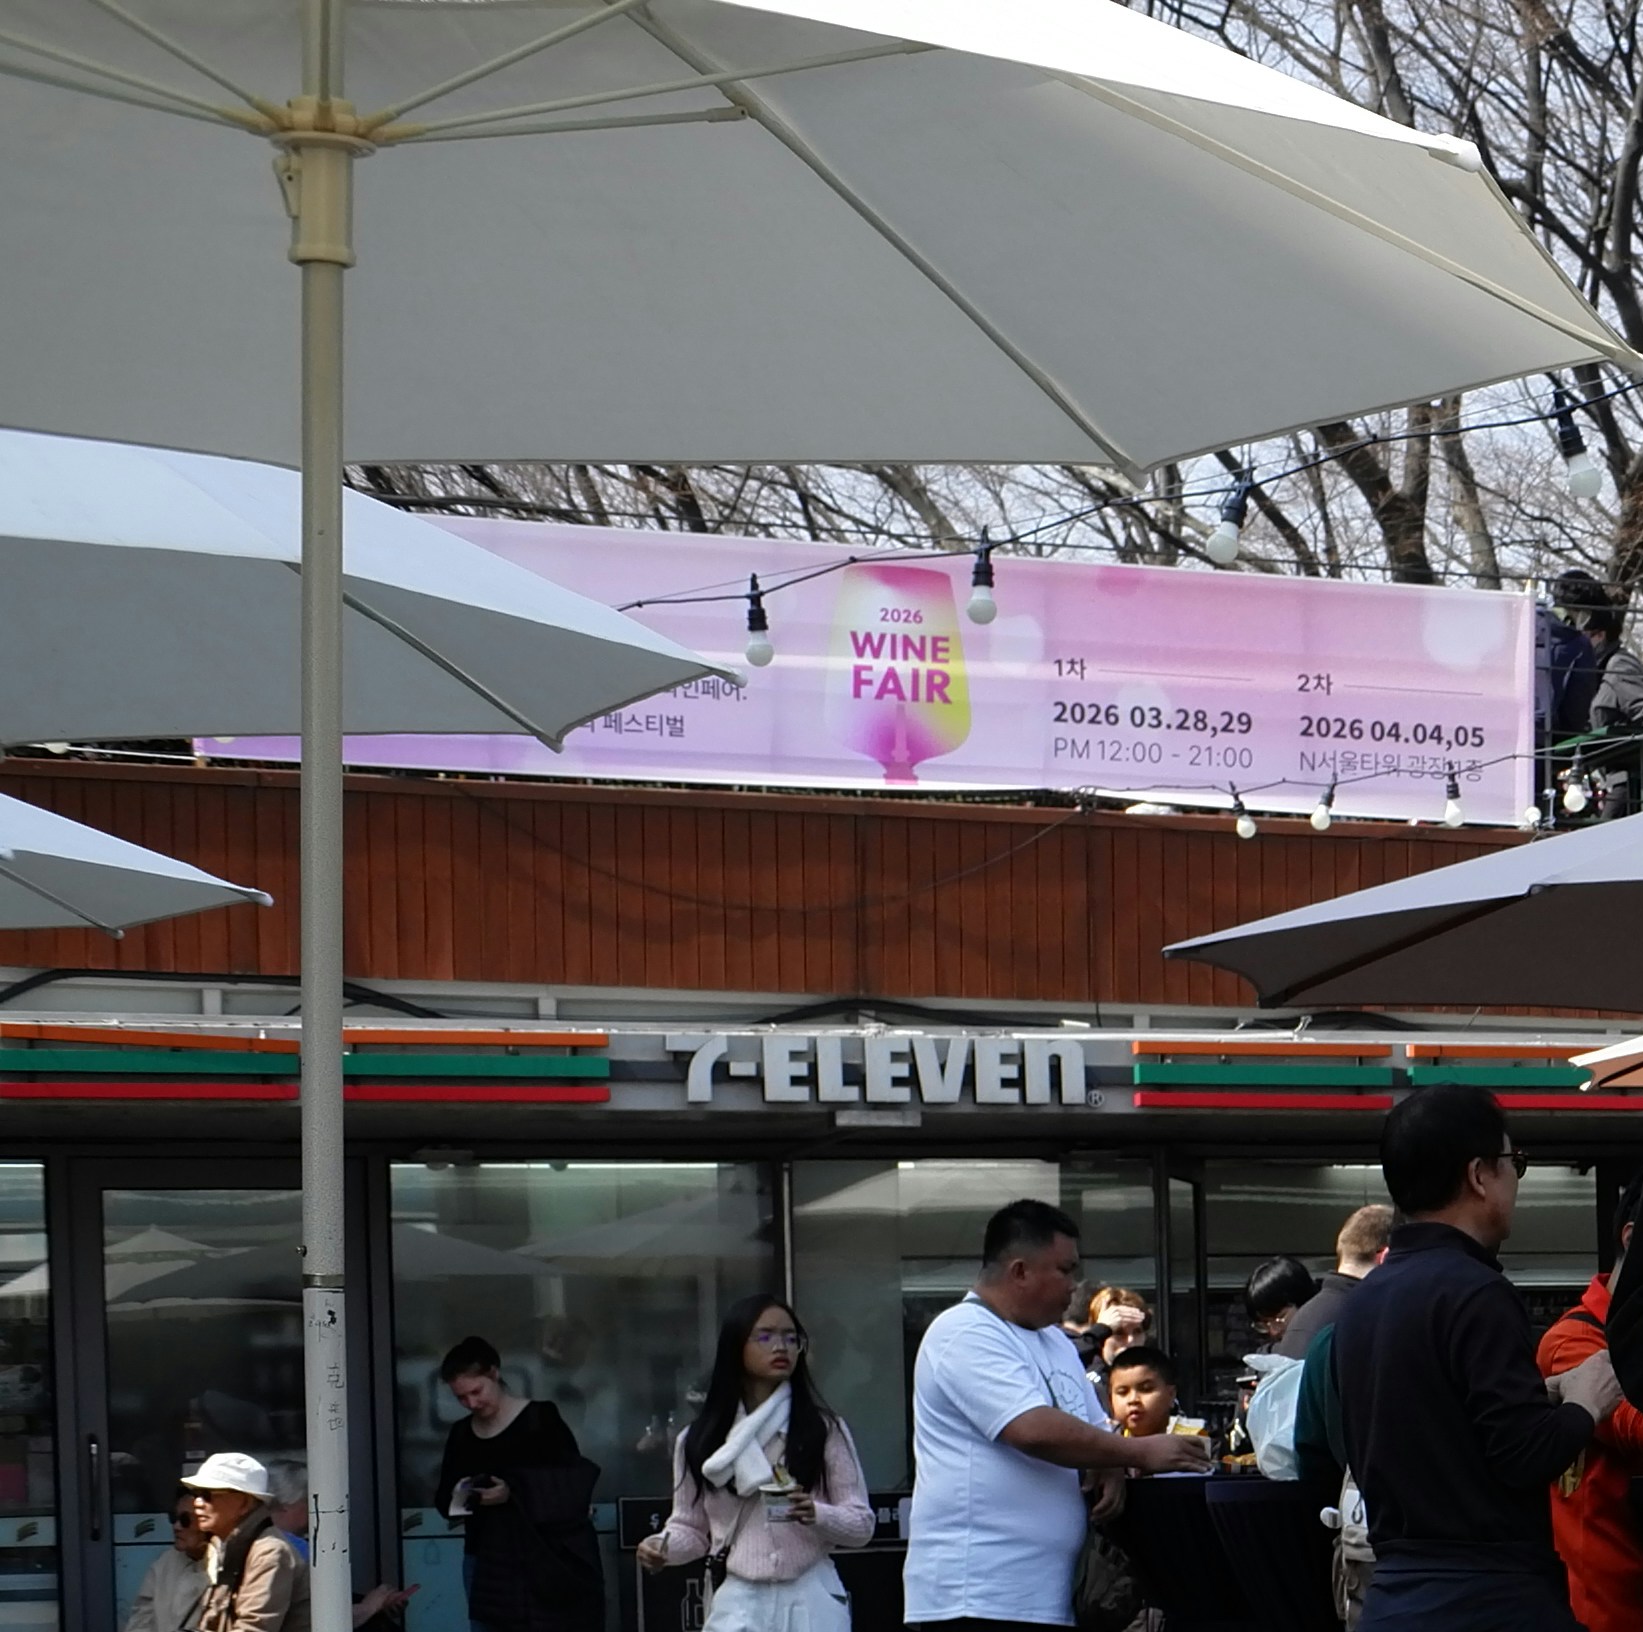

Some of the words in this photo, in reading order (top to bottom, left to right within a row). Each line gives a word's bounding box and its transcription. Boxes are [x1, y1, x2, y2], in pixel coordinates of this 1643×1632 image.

[880, 608, 923, 624] 2026
[850, 630, 950, 664] WINE
[1053, 658, 1086, 680] 1차
[853, 665, 952, 705] FAIR
[1297, 673, 1333, 696] 2차
[602, 711, 686, 739] 페스티벌
[1053, 701, 1119, 726] 2026
[1130, 706, 1253, 738] 03.28,29
[1300, 716, 1363, 740] 2026
[1370, 720, 1485, 751] 04.04,05
[1054, 737, 1090, 760] PM
[1097, 740, 1162, 764] 12:00
[1189, 745, 1253, 769] 21:00
[1300, 750, 1400, 778] N서울타워
